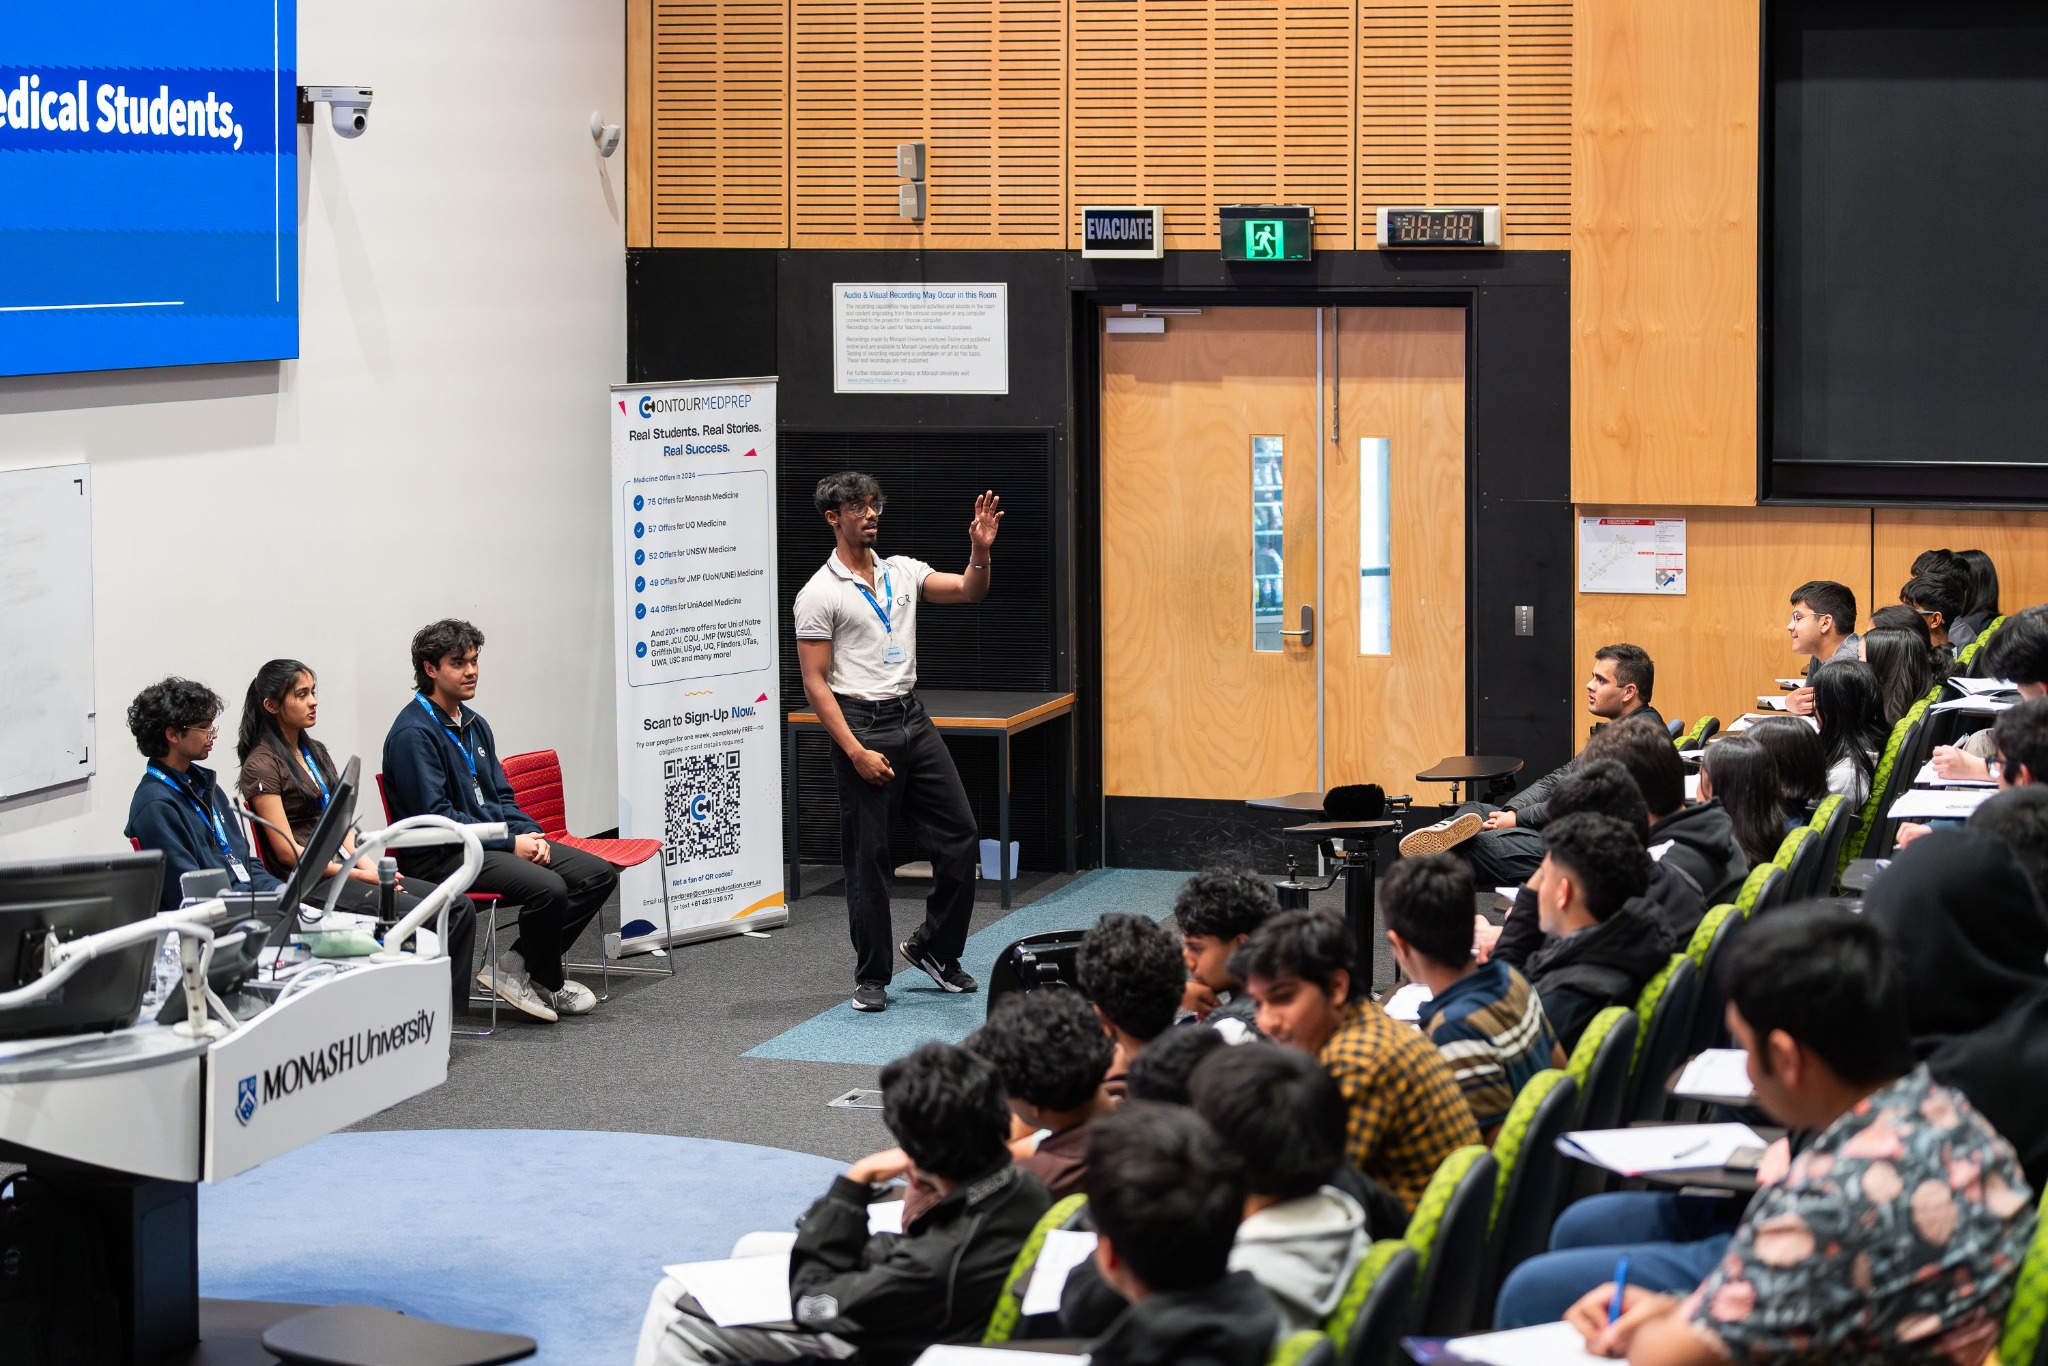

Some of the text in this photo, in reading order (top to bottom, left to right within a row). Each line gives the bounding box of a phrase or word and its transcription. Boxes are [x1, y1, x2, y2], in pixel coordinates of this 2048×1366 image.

[96, 84, 242, 151] Students,
[1087, 218, 1152, 240] EVACUATE
[890, 292, 920, 300] Recording
[923, 292, 935, 300] May
[630, 422, 761, 441] Real Students. Real Stories.
[664, 444, 730, 456] Real Success.
[713, 492, 739, 500] Medicine
[686, 547, 707, 555] UNSW
[709, 545, 736, 553] Medicine
[687, 574, 701, 582] JMP
[703, 571, 736, 581] (UoN/UNE)
[737, 569, 763, 577] Medicine
[688, 600, 713, 608] UniAdel
[897, 594, 911, 606] CR
[651, 629, 664, 637] And
[666, 628, 679, 636] 200+
[671, 636, 683, 645] JCU,
[684, 634, 700, 642] CQU,
[702, 633, 716, 641] JMP
[684, 644, 703, 653] USyd,
[704, 642, 716, 650] UQ,
[670, 656, 680, 664] USC
[682, 654, 692, 662] and
[644, 706, 756, 730] Scan to Sign-Up Now.
[657, 738, 676, 746] program
[712, 728, 741, 737] completely
[715, 870, 733, 879] codes?
[643, 898, 656, 906] Email
[263, 1009, 434, 1105] MONASH University
